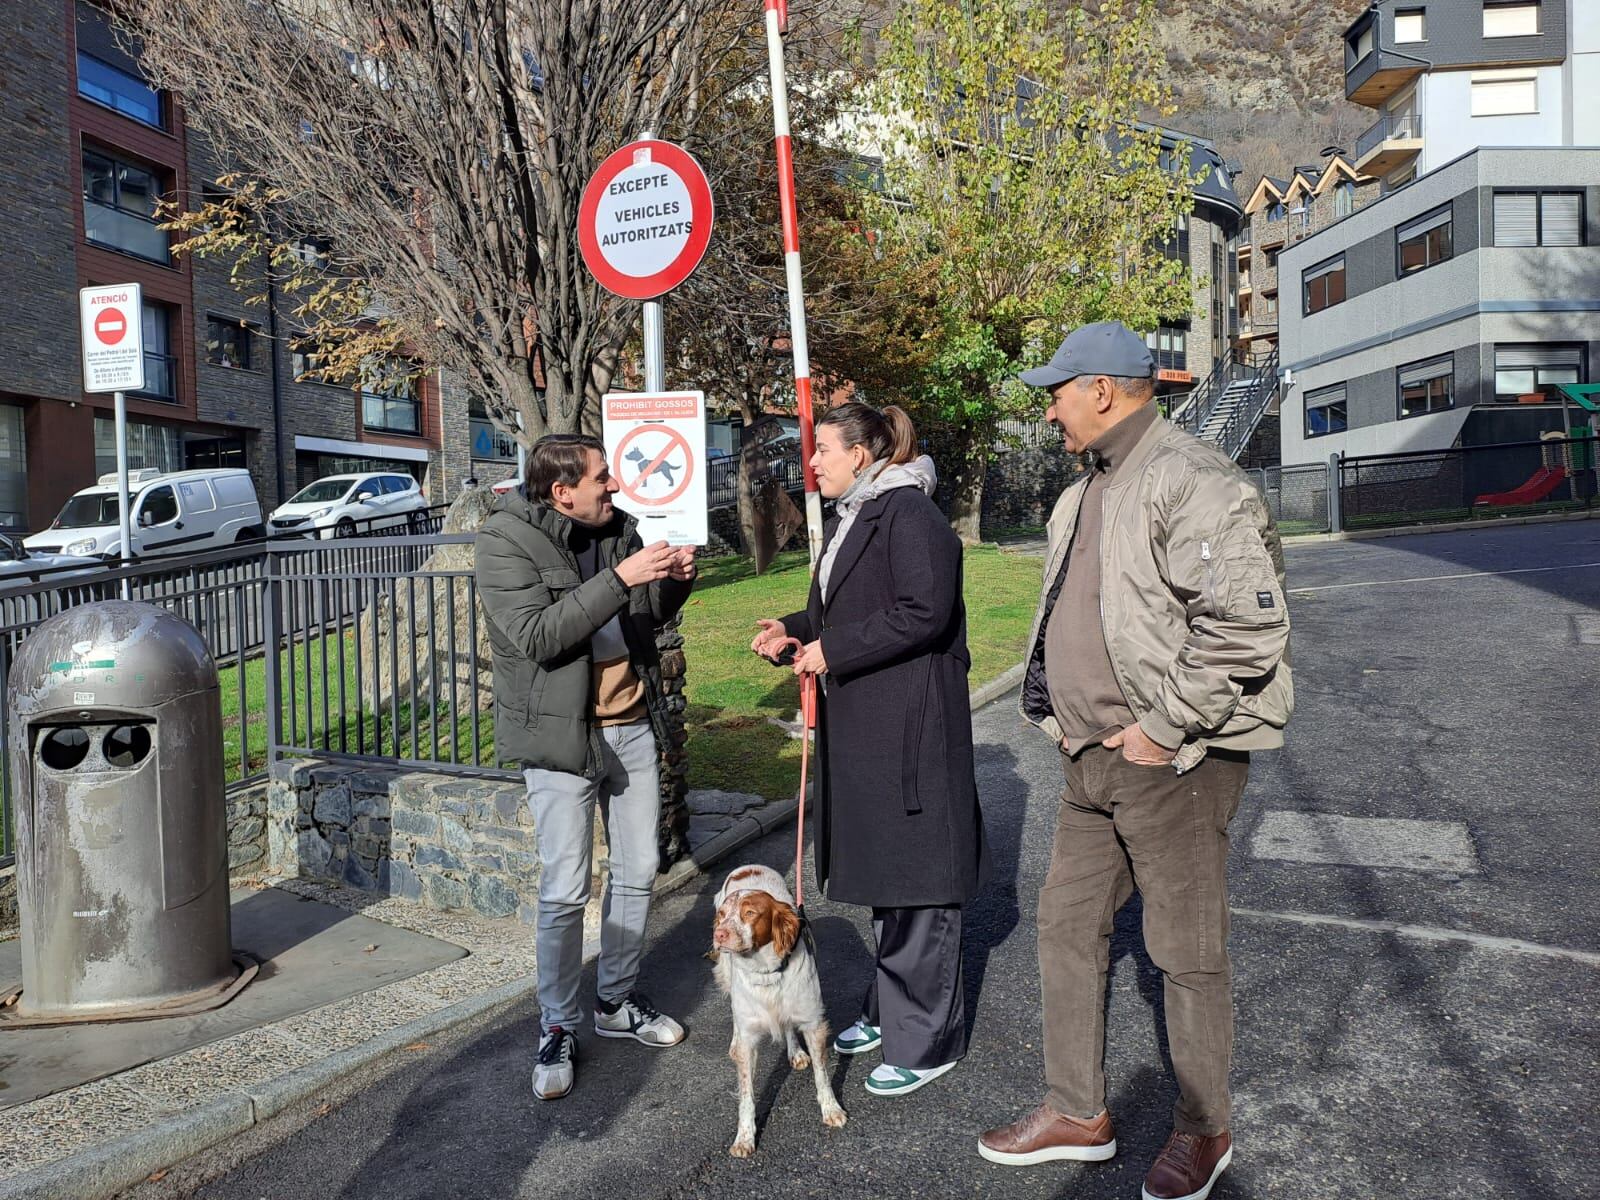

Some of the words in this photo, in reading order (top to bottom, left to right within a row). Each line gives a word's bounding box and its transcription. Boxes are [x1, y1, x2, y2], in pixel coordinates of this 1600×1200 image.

[609, 174, 669, 196] EXCEPTE
[614, 201, 680, 223] VEHICLES
[601, 221, 693, 247] AUTORITZATS
[90, 292, 128, 304] ATENCIÓ
[610, 400, 652, 410] PROHIBIT
[654, 399, 694, 408] GOSSOS
